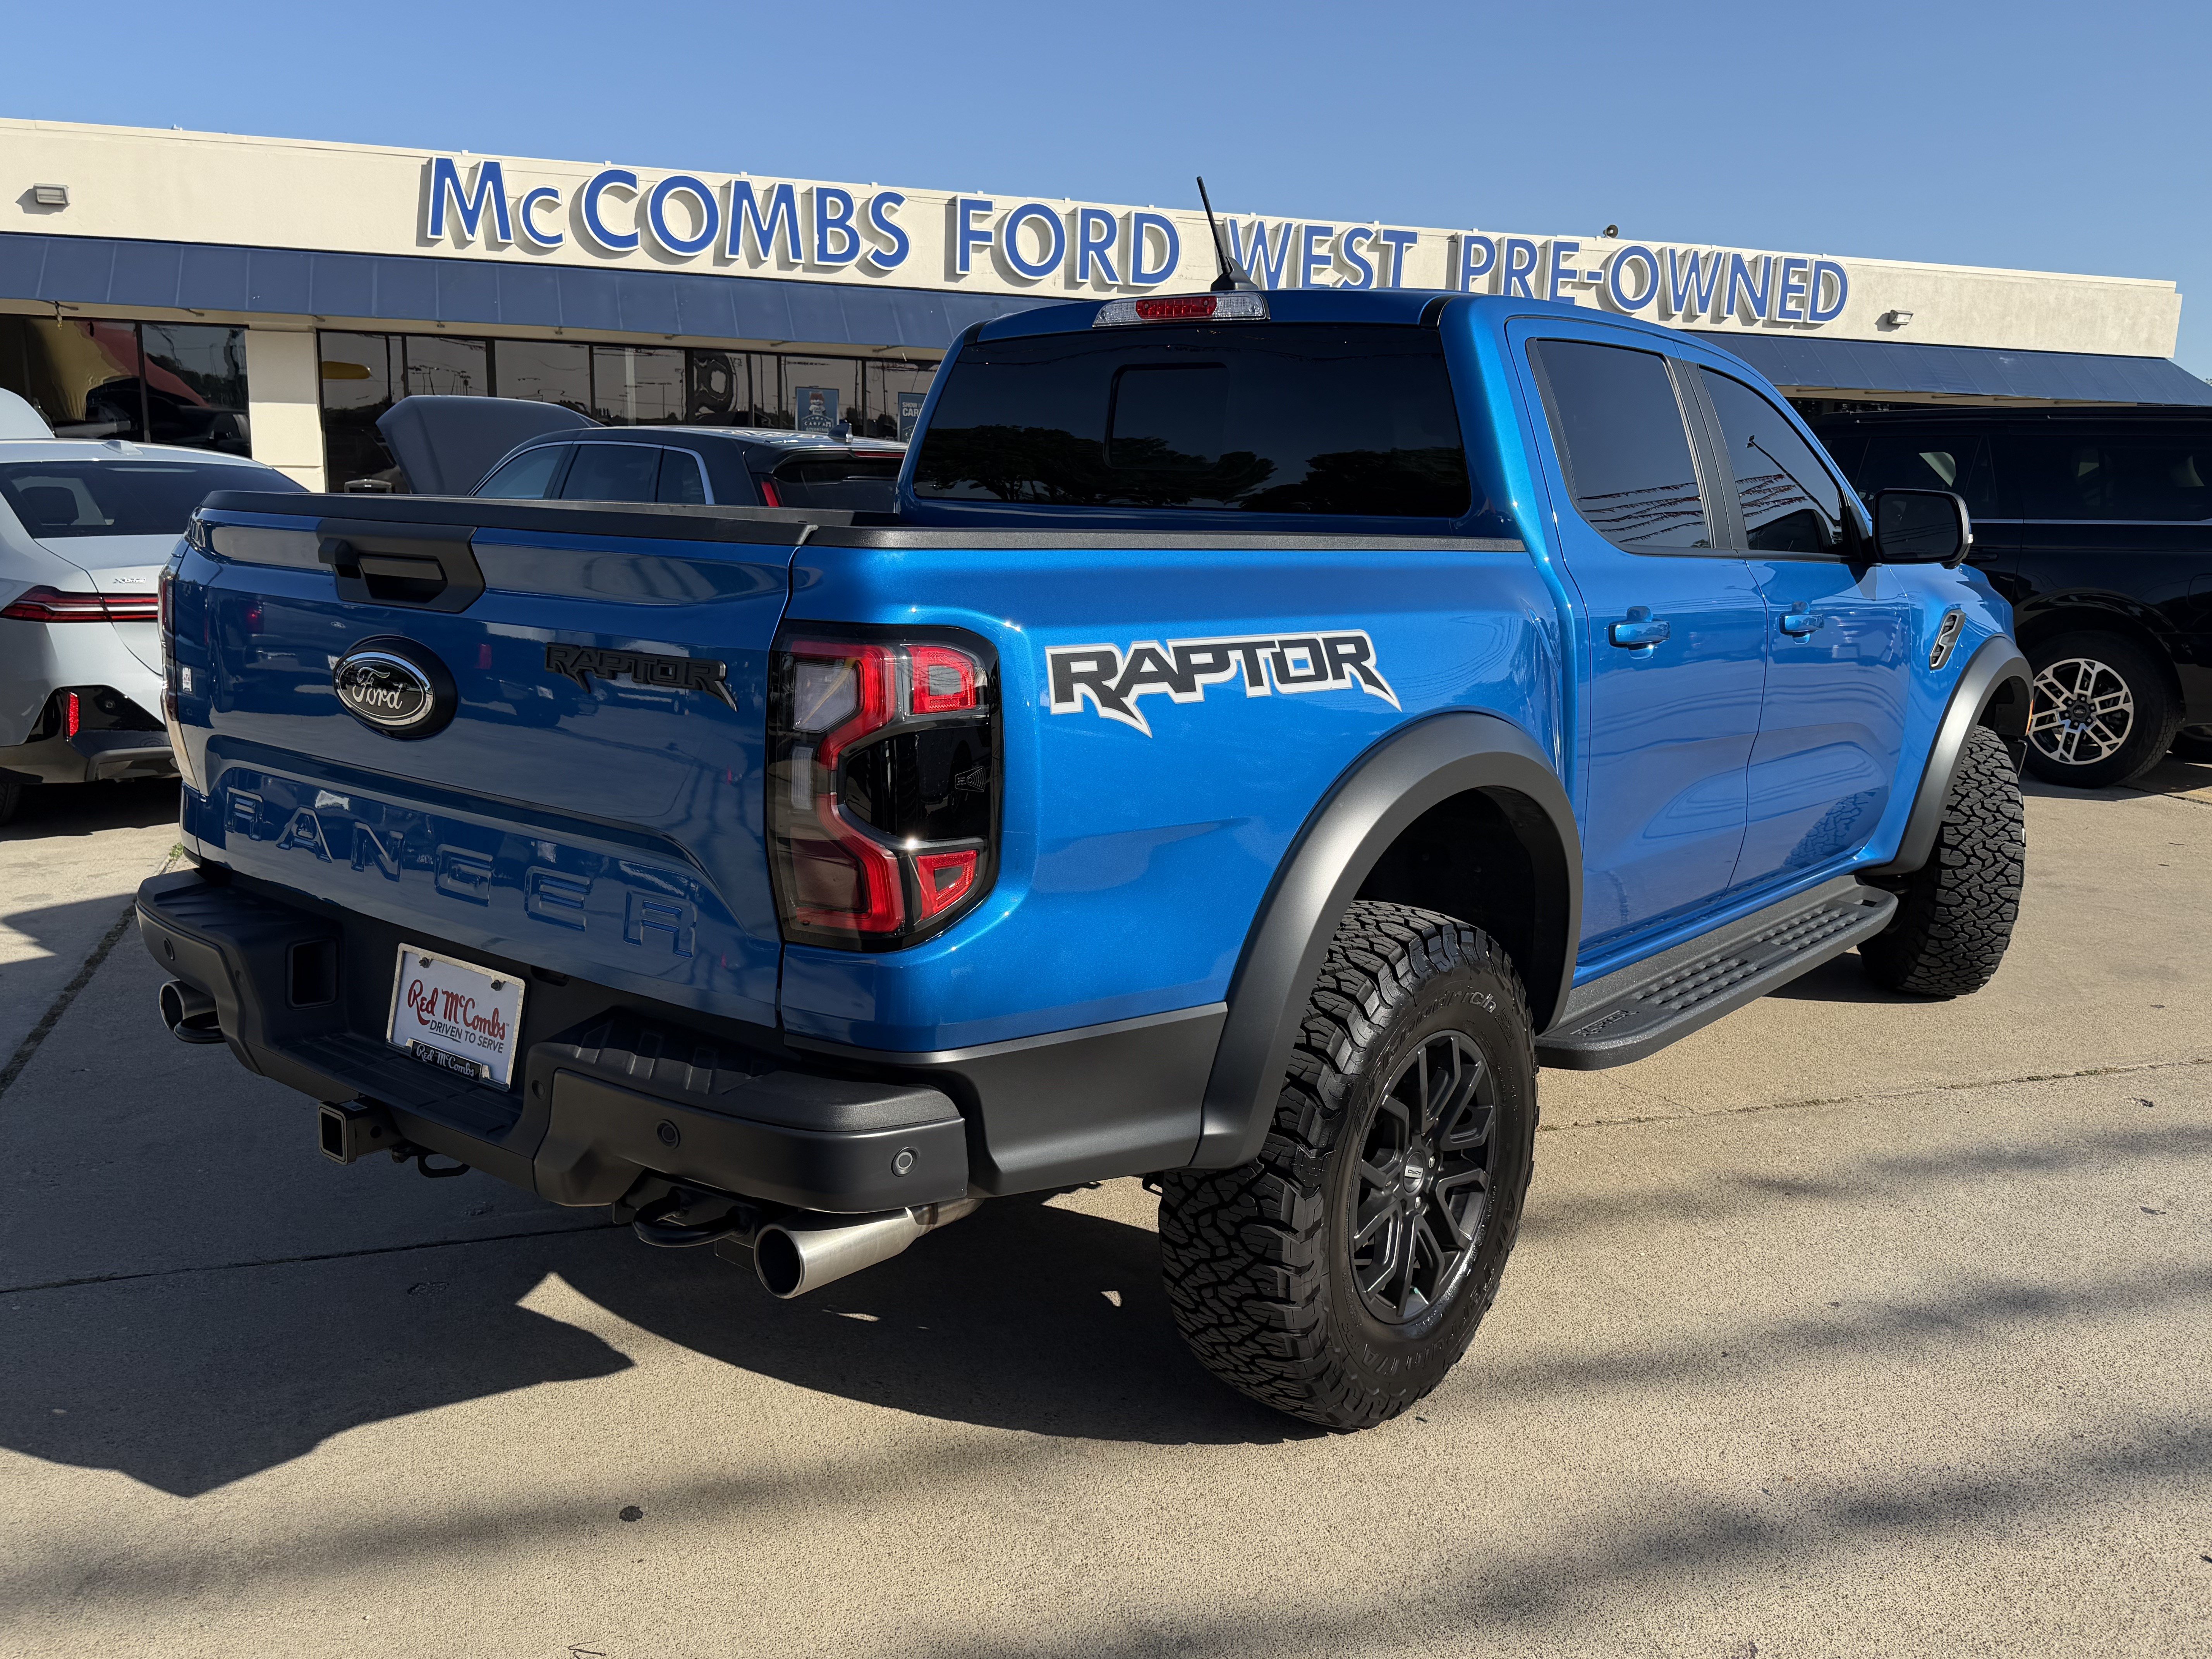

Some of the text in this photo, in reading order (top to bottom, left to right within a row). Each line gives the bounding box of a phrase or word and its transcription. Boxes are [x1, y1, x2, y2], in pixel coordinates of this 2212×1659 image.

[427, 155, 1850, 324] McCOMBS FORD WEST PRE-OWNED
[902, 408, 920, 417] CAR
[352, 666, 402, 709] Ford
[544, 642, 737, 712] RAPTOR
[1045, 629, 1402, 738] RAPTOR
[225, 787, 697, 958] RANGER
[408, 979, 506, 1041] Red McCombs
[430, 1020, 504, 1053] DRIVEN TO SERVE
[416, 1044, 474, 1077] Red McCombs
